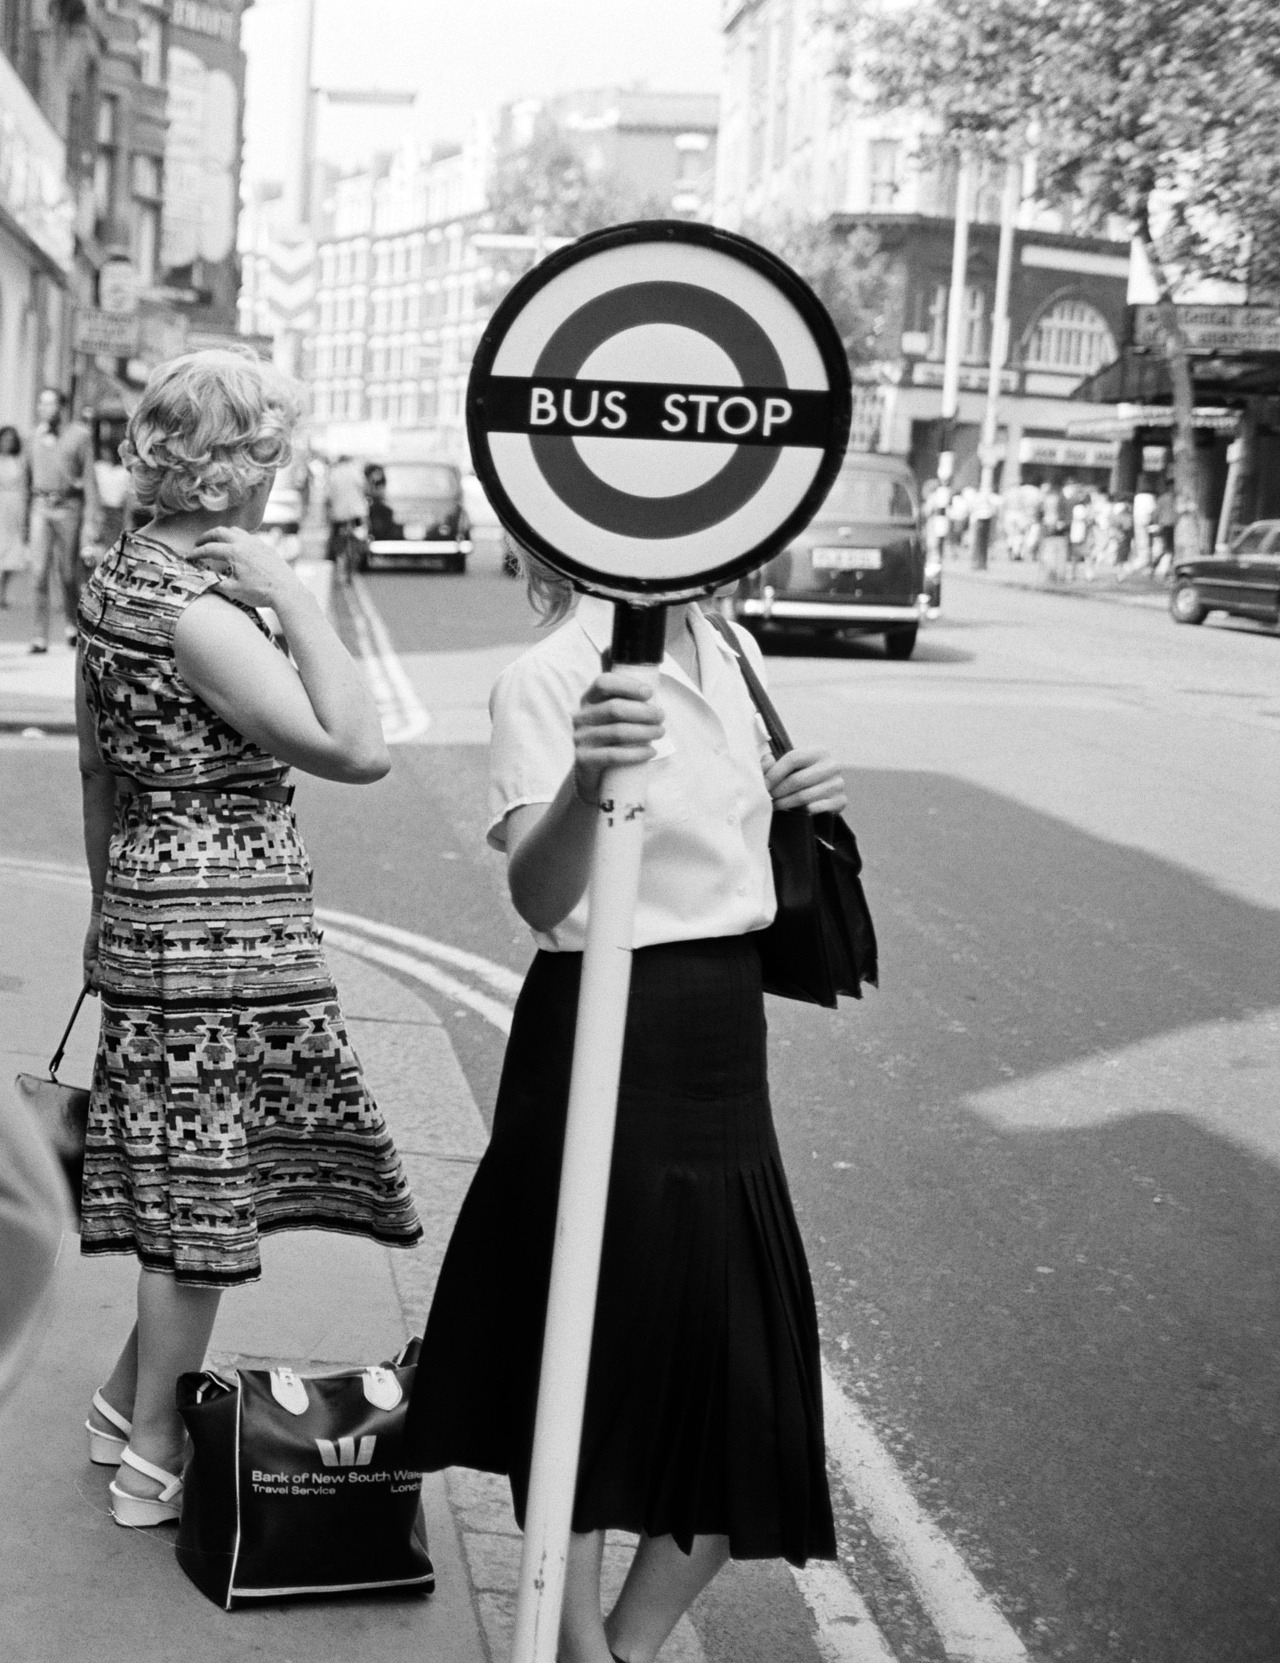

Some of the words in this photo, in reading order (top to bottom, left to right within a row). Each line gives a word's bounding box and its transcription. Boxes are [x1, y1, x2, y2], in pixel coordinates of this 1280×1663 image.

[529, 387, 628, 430] BUS
[661, 393, 793, 437] STOP
[252, 1470, 290, 1483] Bank
[292, 1472, 310, 1484] of
[311, 1473, 346, 1484] New
[348, 1471, 391, 1484] South
[393, 1469, 423, 1482] Wale
[252, 1484, 289, 1495] Travel
[291, 1485, 336, 1496] Service
[390, 1481, 422, 1493] Lond
